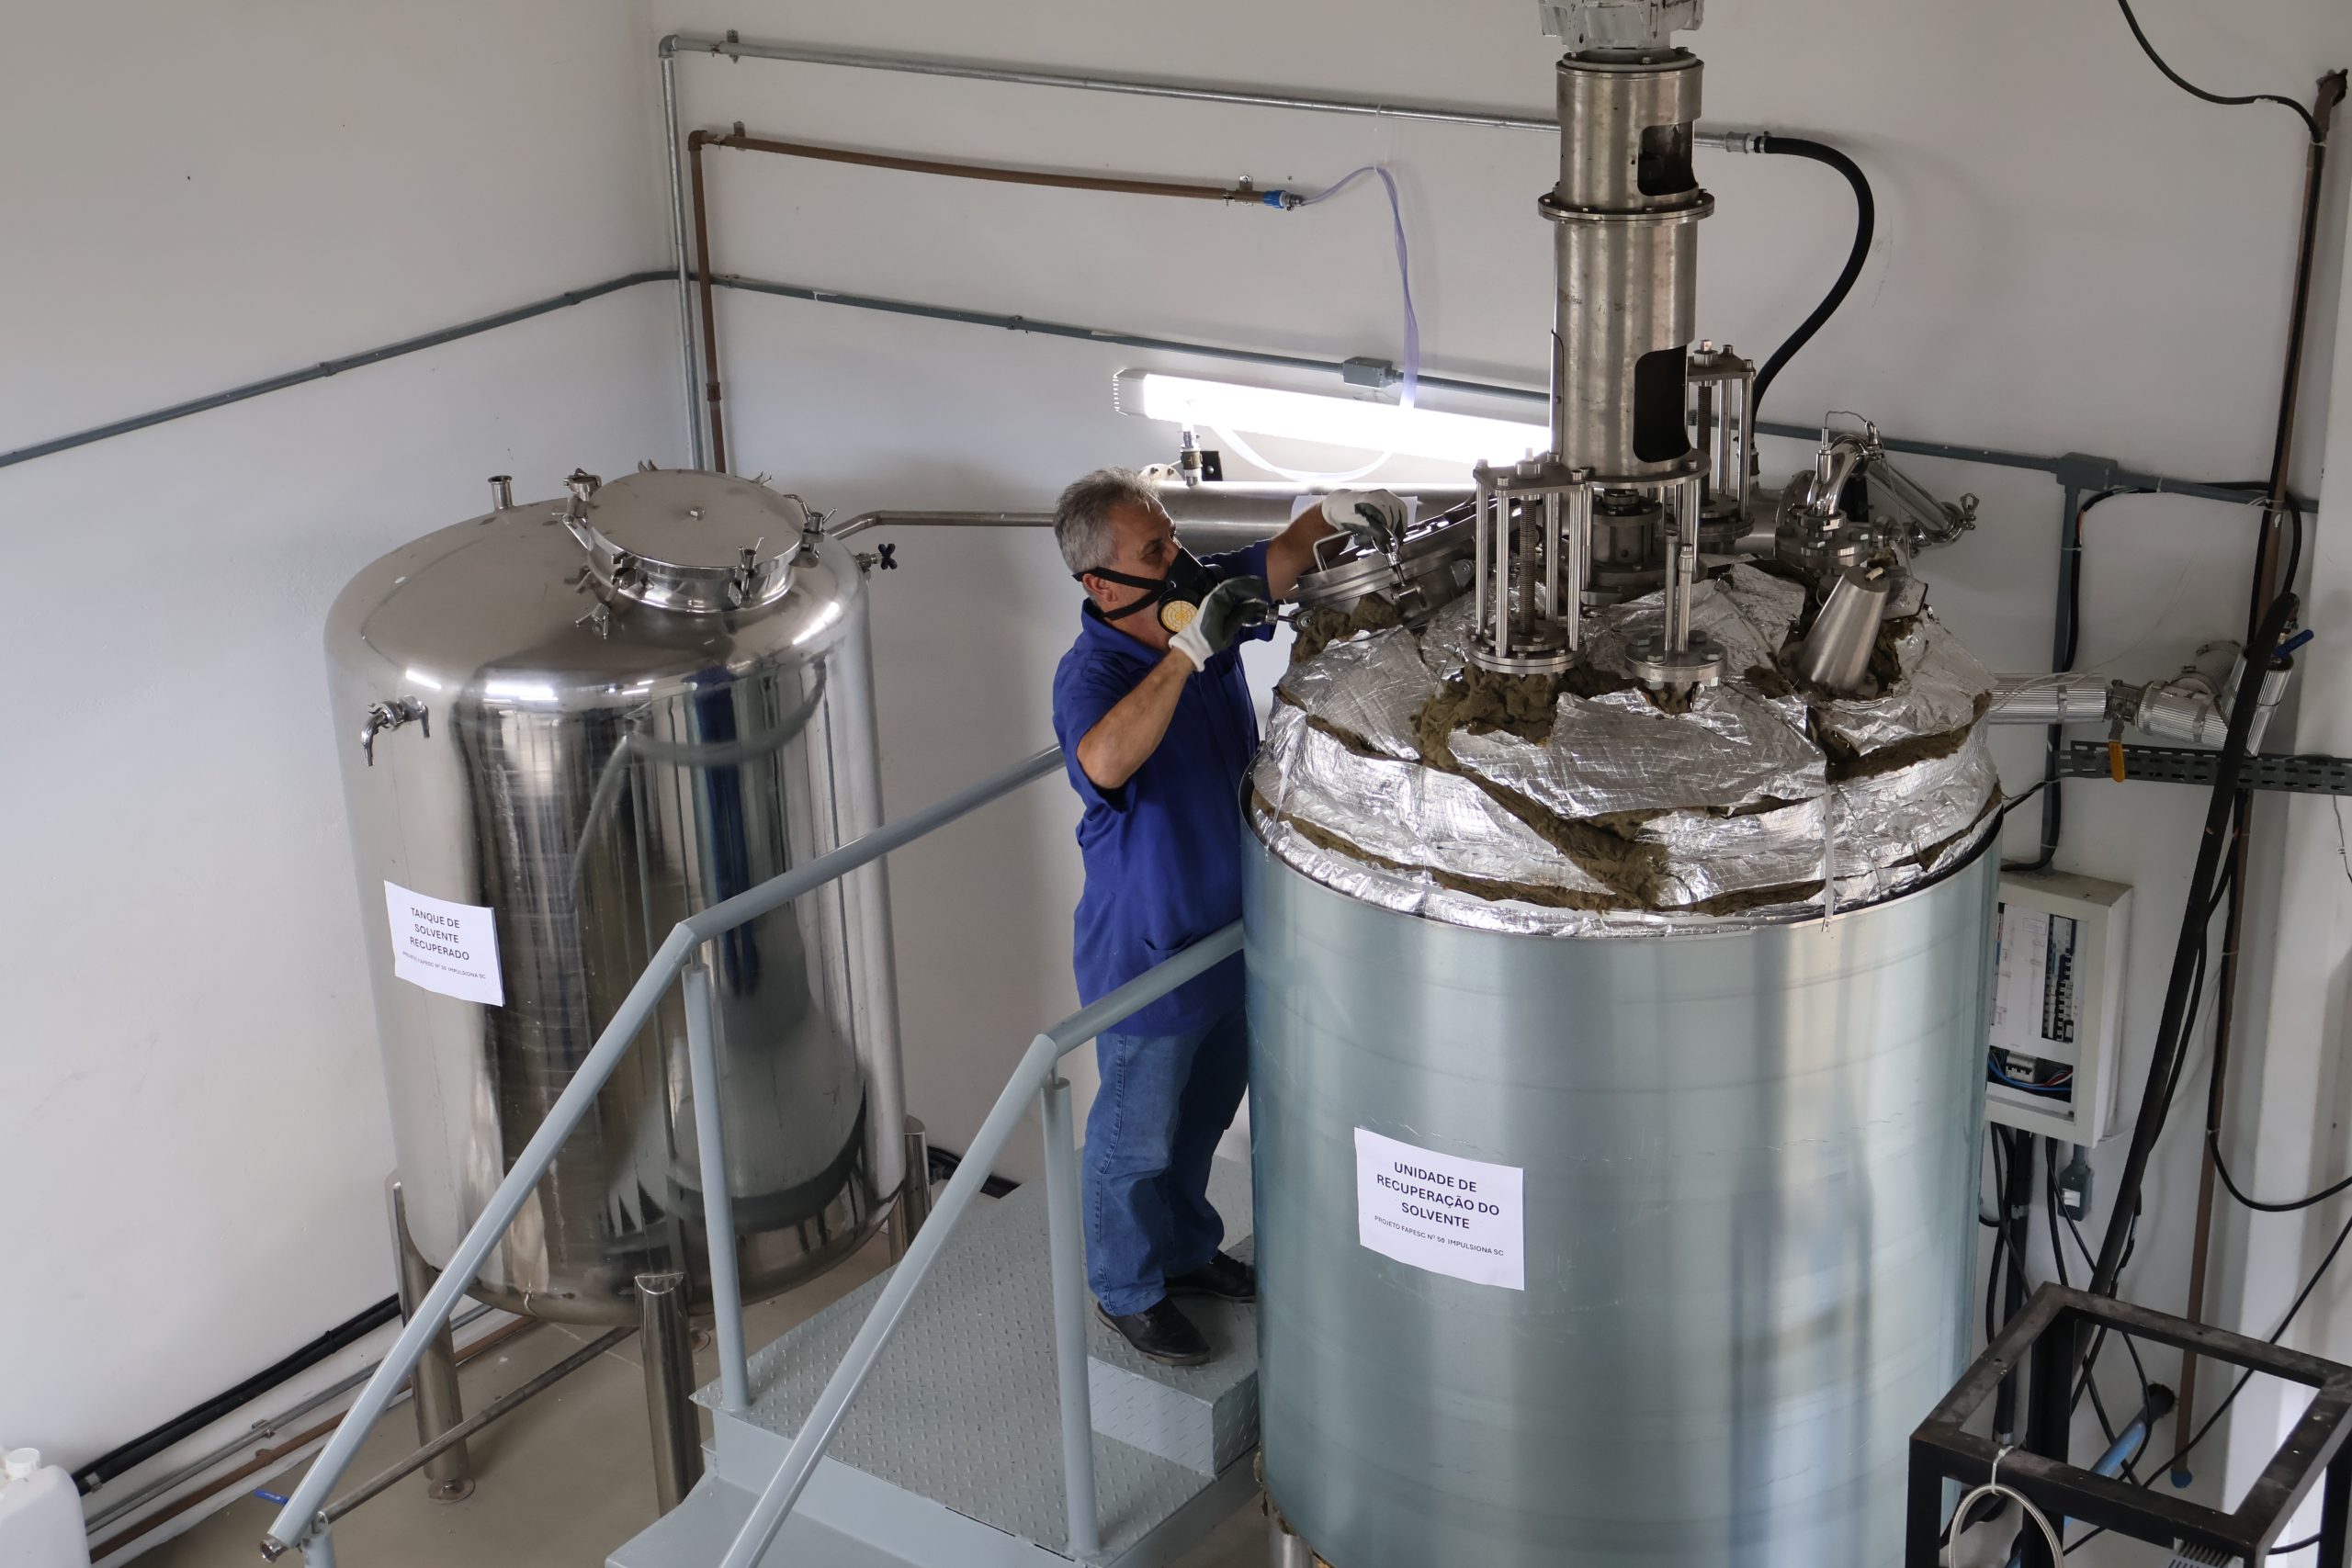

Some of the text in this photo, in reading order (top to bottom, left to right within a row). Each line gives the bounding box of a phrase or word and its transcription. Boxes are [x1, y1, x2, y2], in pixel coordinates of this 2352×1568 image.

[411, 908, 460, 929] TANQUE DE
[414, 923, 459, 943] SOLVENTE
[410, 937, 469, 960] RECUPERADO
[1394, 1161, 1477, 1192] UNIDADE DE
[1376, 1174, 1499, 1216] RECUPERAÇÃO DO
[1401, 1201, 1470, 1229] SOLVENTE
[1374, 1214, 1400, 1229] PROJETO
[1401, 1225, 1426, 1238] FAPESC
[1447, 1238, 1492, 1254] IMPULSIONA
[1493, 1248, 1504, 1257] SC
